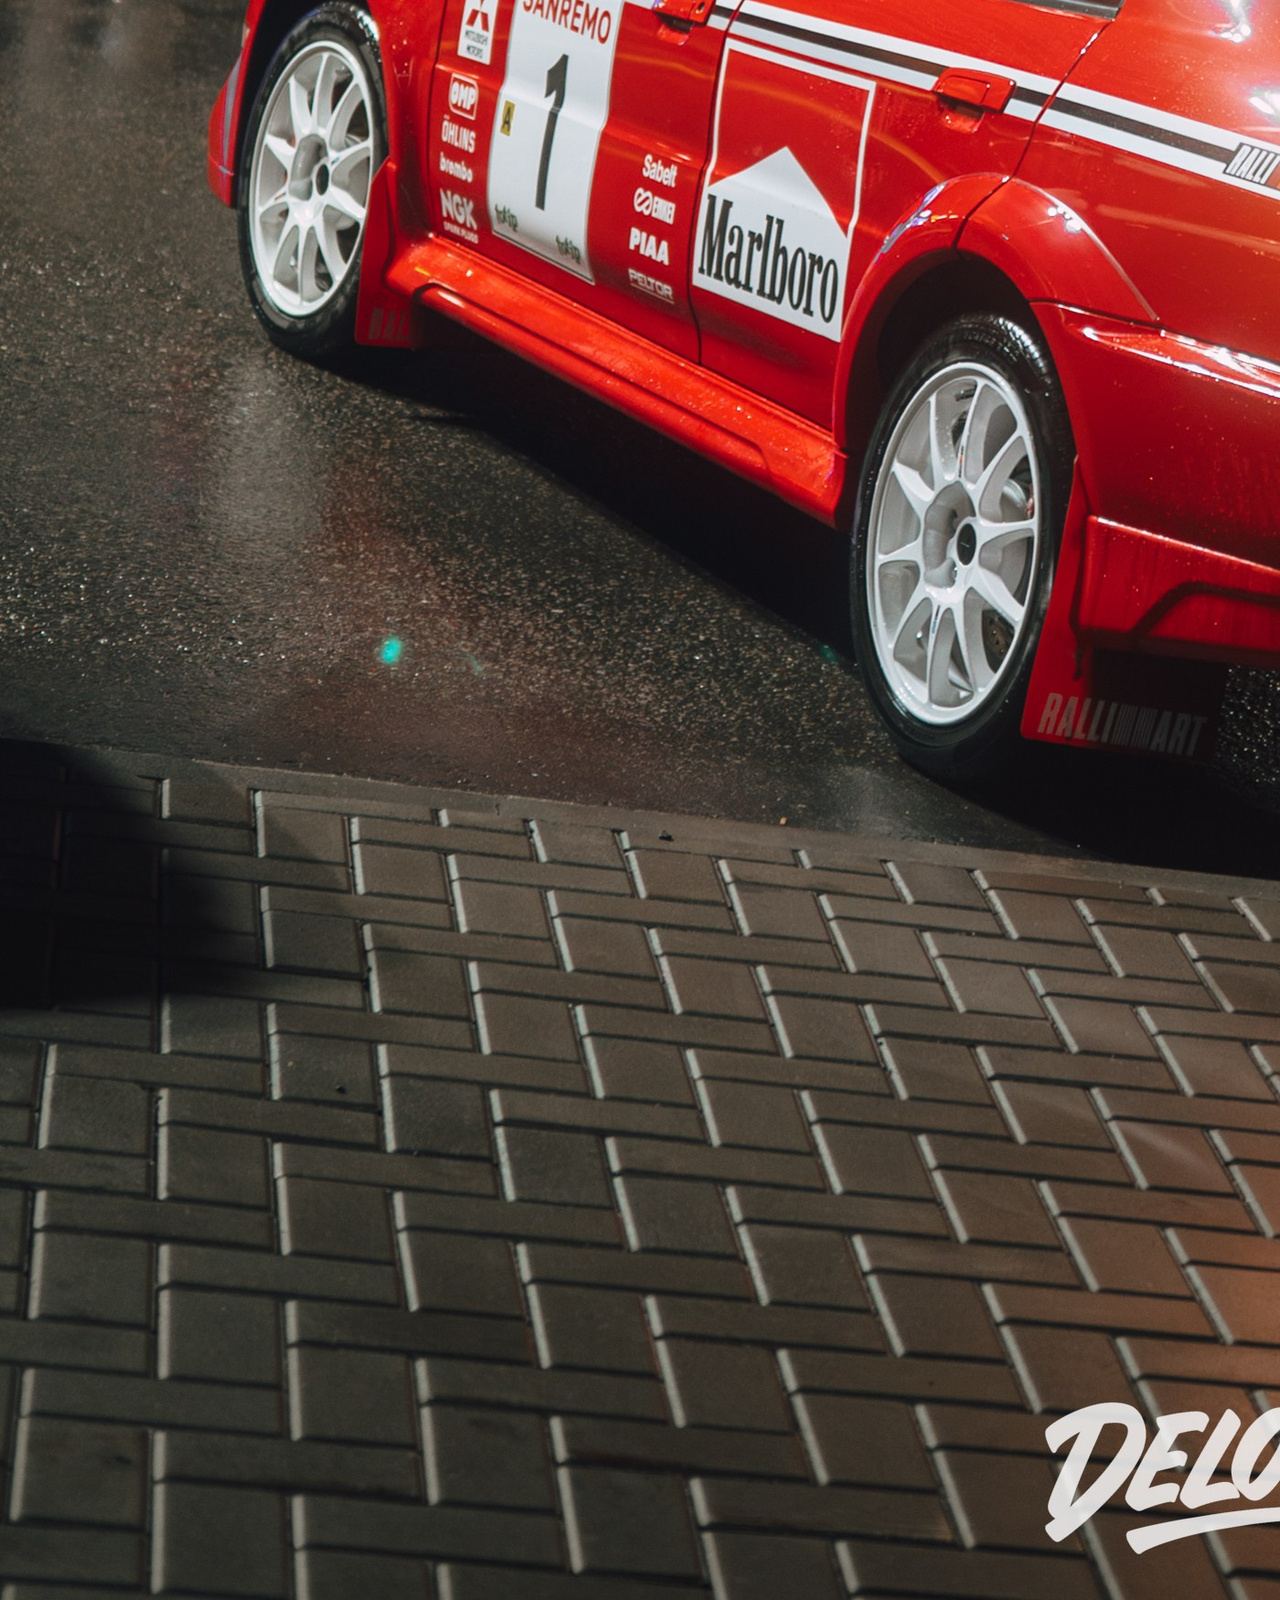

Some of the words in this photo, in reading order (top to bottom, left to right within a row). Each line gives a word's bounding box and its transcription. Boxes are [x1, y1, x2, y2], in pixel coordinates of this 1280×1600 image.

[450, 81, 477, 111] OMP
[441, 115, 476, 154] ÖHLINS
[502, 105, 512, 131] A
[535, 53, 569, 211] 1
[439, 151, 474, 183] brembo
[642, 154, 678, 188] Sabelt
[440, 187, 478, 231] NGK
[629, 227, 670, 266] PIAA
[698, 194, 839, 324] Marlboro
[628, 268, 674, 300] PELTOR
[1037, 692, 1118, 744] RALLI
